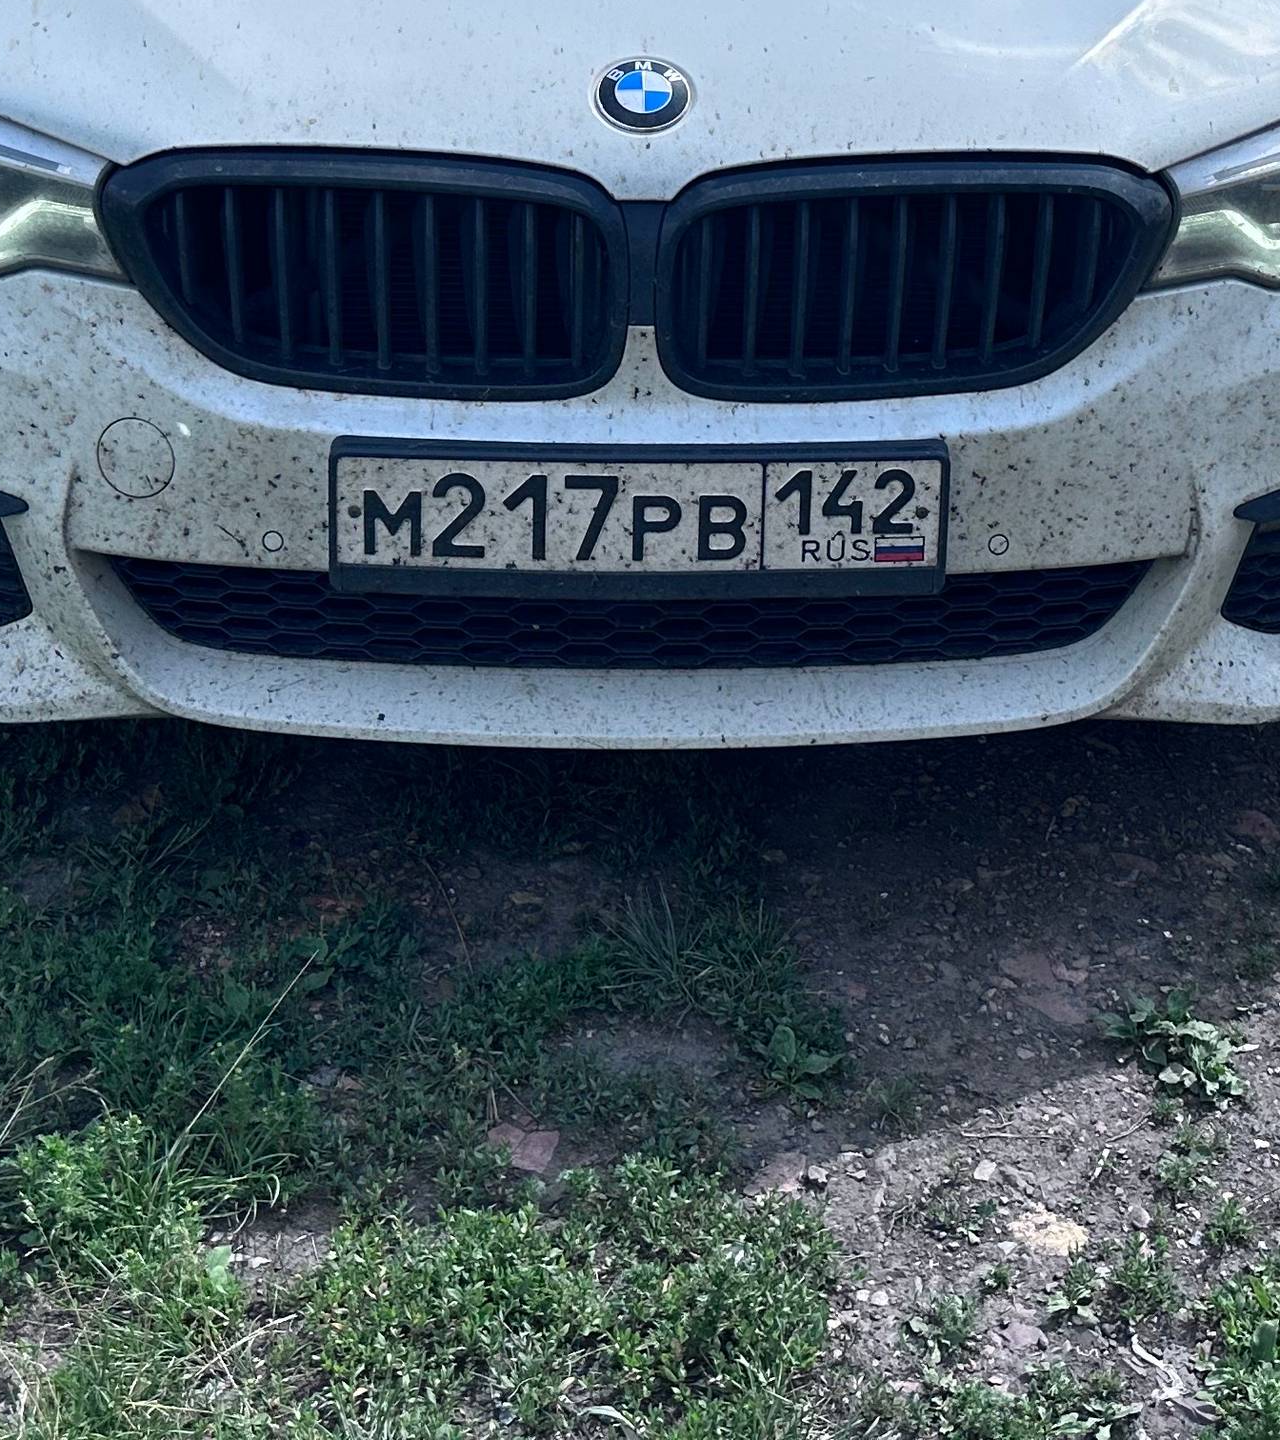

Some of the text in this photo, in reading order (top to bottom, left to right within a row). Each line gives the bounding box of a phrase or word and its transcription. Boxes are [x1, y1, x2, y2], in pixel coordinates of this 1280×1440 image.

[606, 61, 683, 82] BMW
[774, 468, 914, 535] 142
[801, 536, 870, 562] RUS
